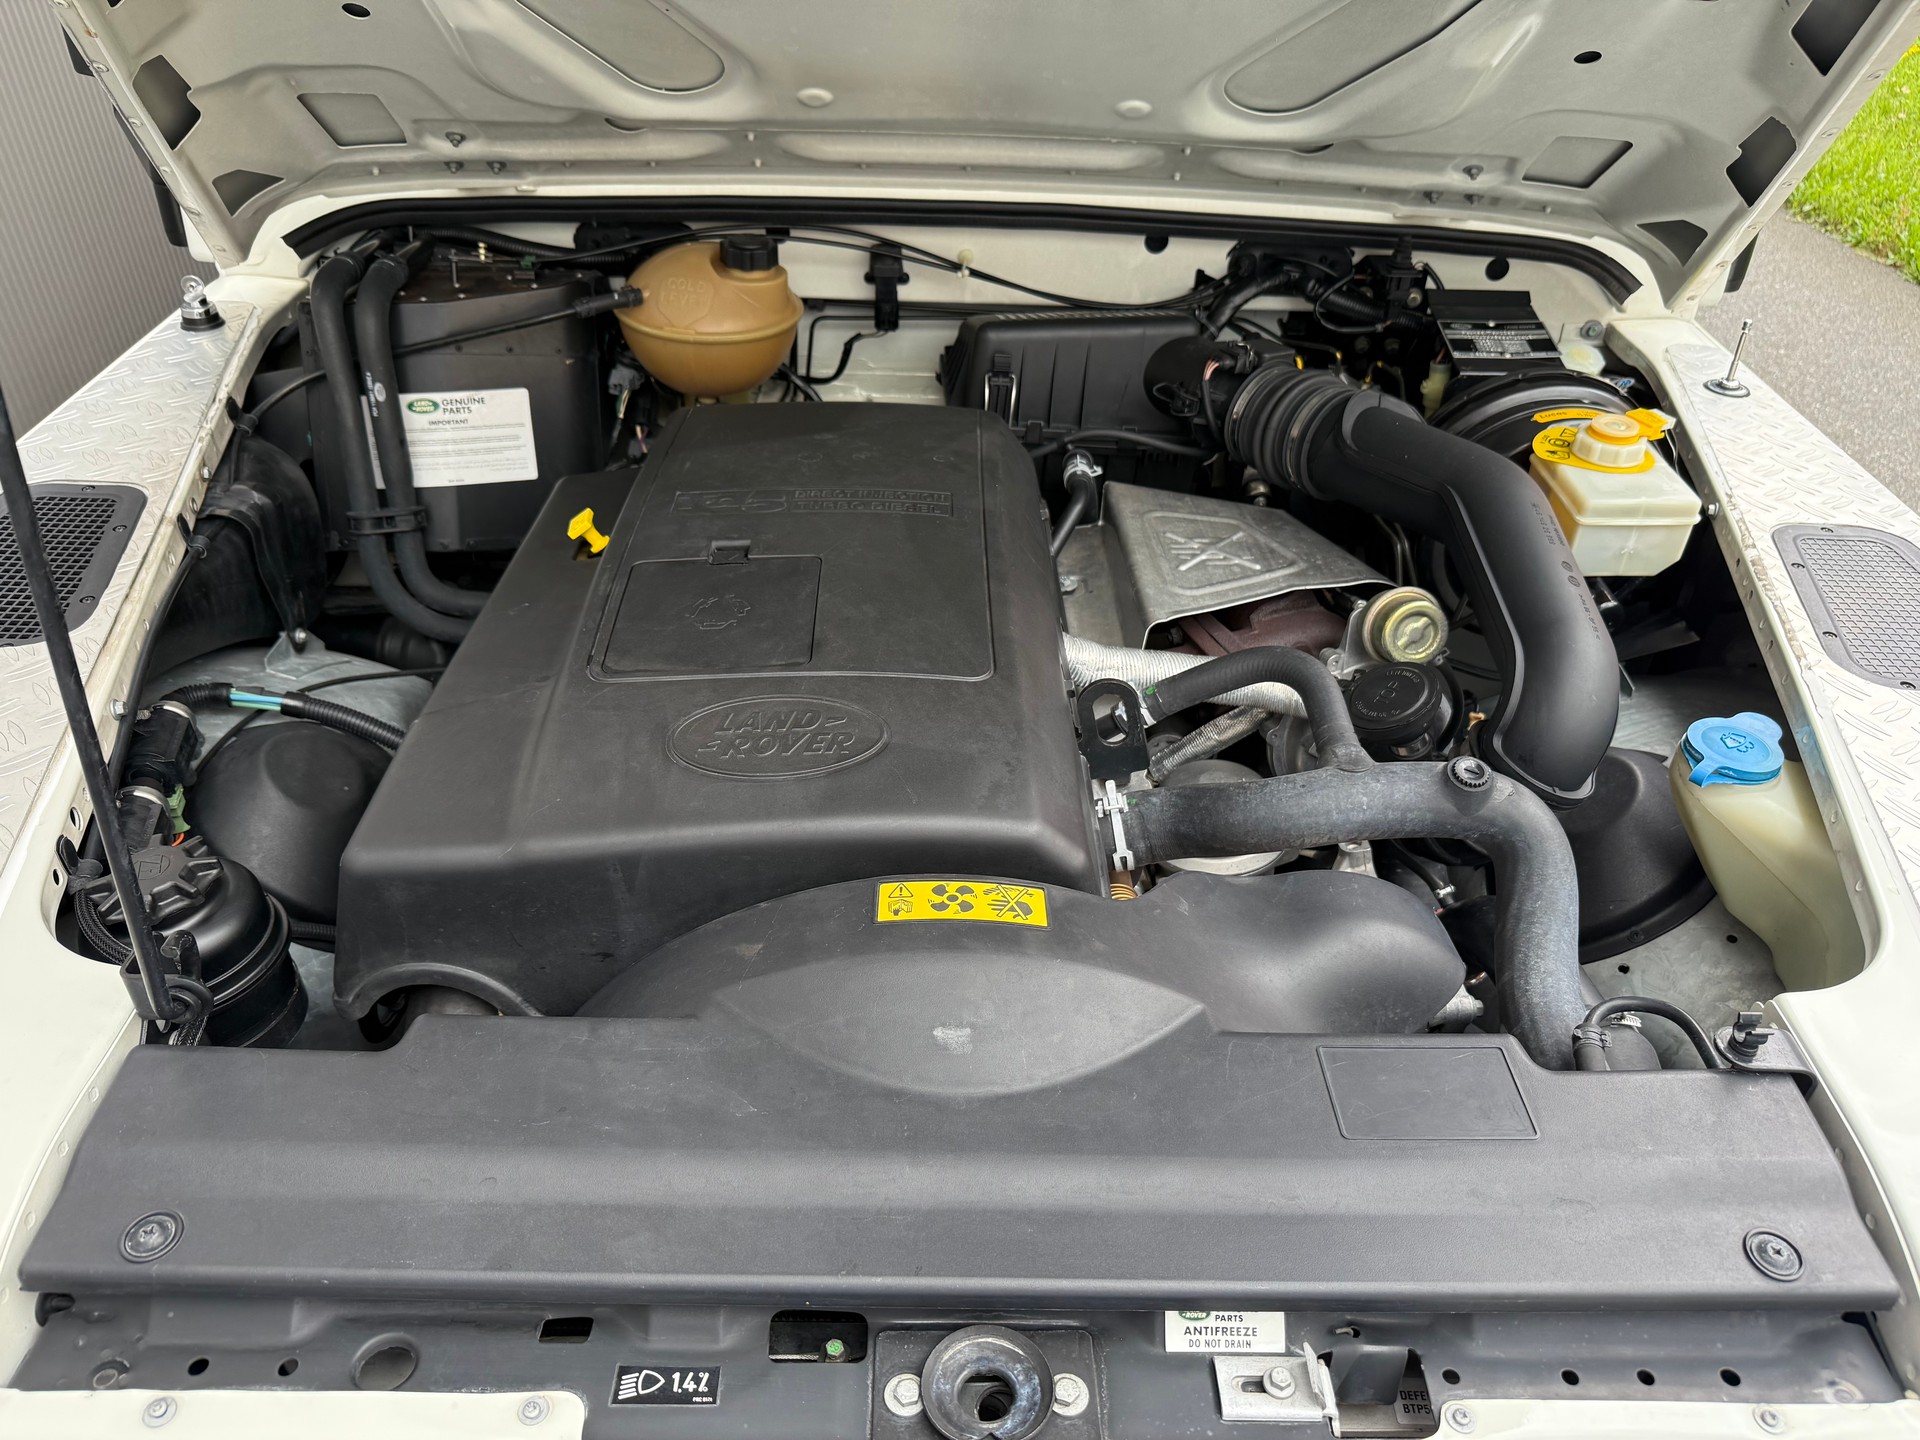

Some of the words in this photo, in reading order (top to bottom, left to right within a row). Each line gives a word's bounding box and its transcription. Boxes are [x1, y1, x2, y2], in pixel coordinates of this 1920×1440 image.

[667, 276, 706, 293] COLD
[441, 397, 487, 407] GENUINE
[442, 406, 473, 416] PARTS
[428, 418, 469, 426] IMPORTANT
[715, 709, 823, 735] LAND
[719, 731, 856, 759] ROVER
[1214, 1314, 1244, 1323] PARTS
[1183, 1326, 1258, 1337] ANTIFREEZE
[1188, 1338, 1201, 1348] DO
[1204, 1339, 1221, 1349] NOT
[1224, 1339, 1252, 1349] DRAIN
[671, 1371, 710, 1394] 1.4%
